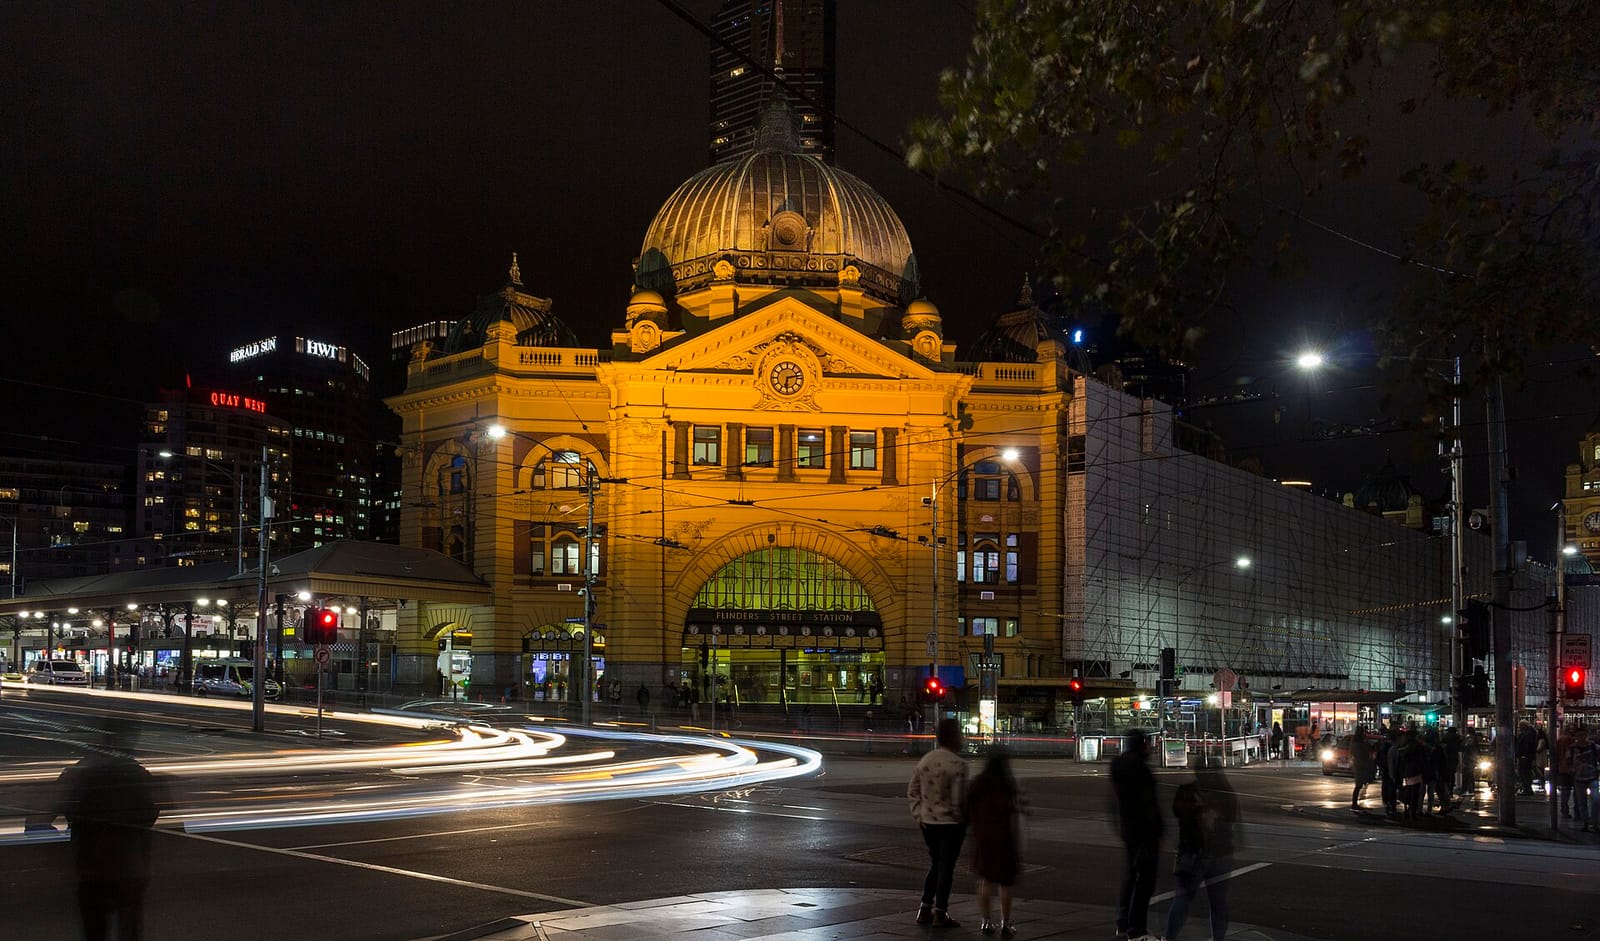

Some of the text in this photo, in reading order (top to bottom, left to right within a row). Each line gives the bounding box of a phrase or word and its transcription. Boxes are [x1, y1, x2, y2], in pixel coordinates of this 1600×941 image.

[230, 339, 277, 362] HERALD SUN
[307, 339, 338, 359] HWT
[211, 392, 266, 413] QUAY WEST
[716, 611, 853, 622] FLINDERS STREET STATION
